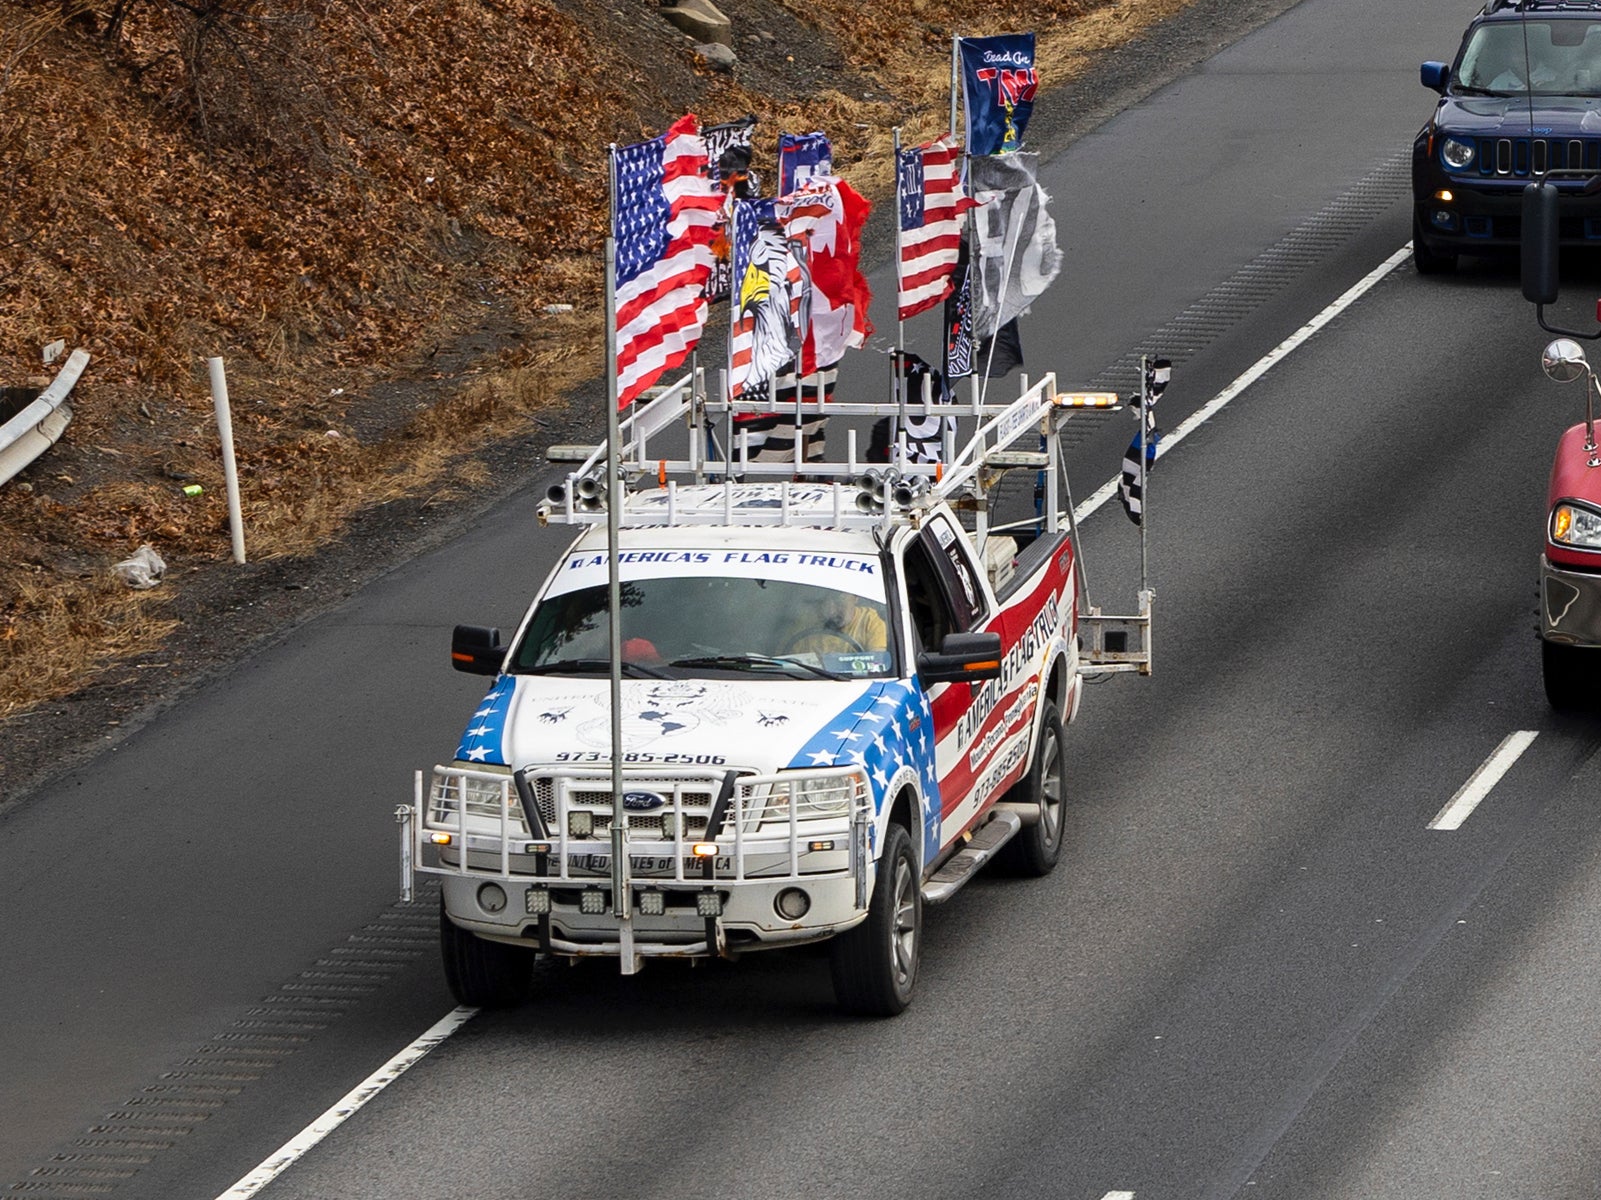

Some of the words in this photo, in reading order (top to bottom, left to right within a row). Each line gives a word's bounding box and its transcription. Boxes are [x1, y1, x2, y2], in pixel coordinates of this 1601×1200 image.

[723, 552, 790, 565] FLAG
[797, 554, 878, 574] TRUCK
[1009, 627, 1035, 682] FLAG
[555, 751, 727, 765] 973-85-2506
[624, 793, 652, 808] Ford
[658, 857, 672, 869] of
